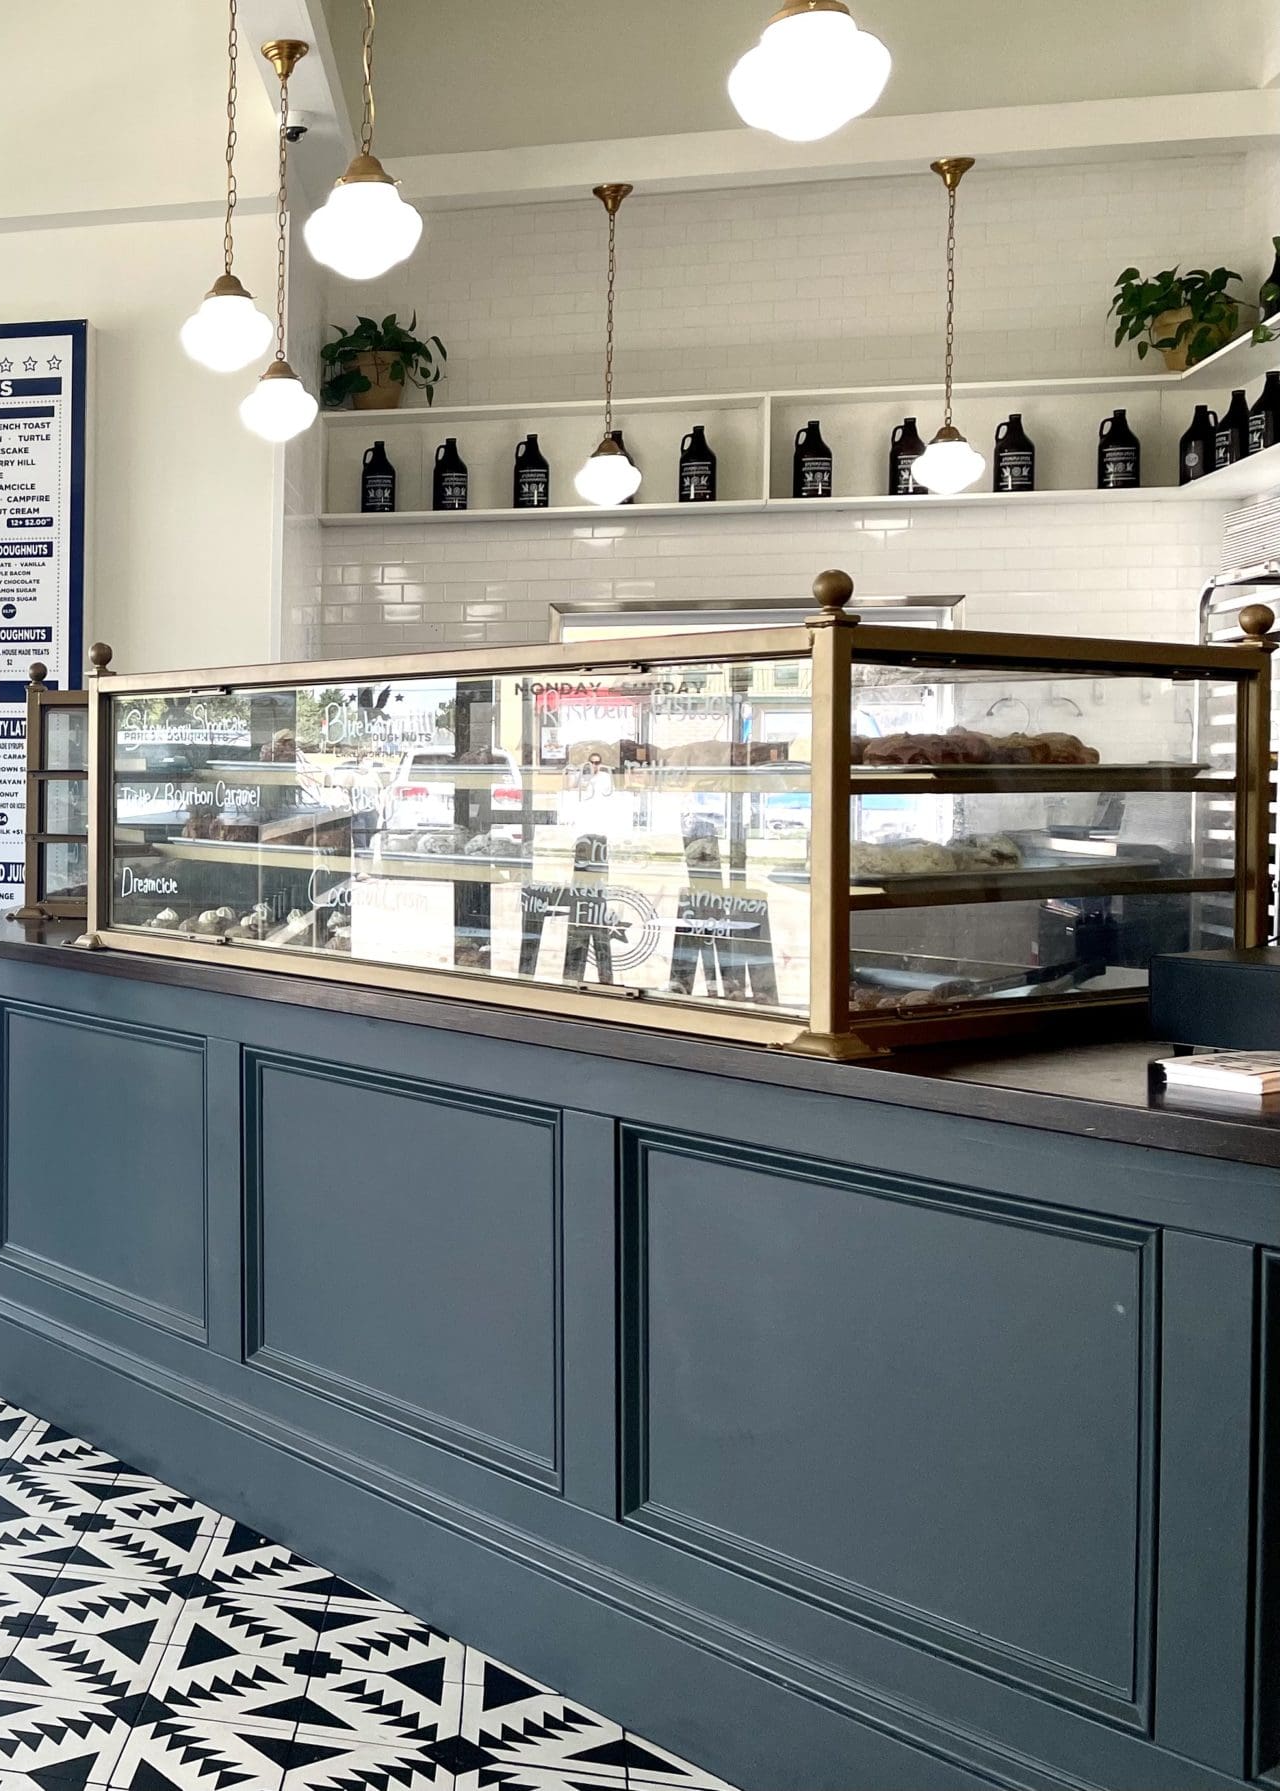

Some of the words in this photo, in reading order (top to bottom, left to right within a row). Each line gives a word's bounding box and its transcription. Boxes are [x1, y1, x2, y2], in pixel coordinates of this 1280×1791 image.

[22, 421, 51, 429] TOAST
[17, 433, 51, 441] TURTLE
[17, 458, 36, 466] HILL
[6, 494, 51, 503] CAMPFIRE
[9, 507, 40, 515] CREAM
[515, 682, 602, 696] MONDAY
[10, 720, 26, 736] LAT
[371, 732, 432, 743] OUGHNUTS
[164, 781, 214, 806] Bourbon
[215, 780, 261, 808] Caramel
[7, 864, 25, 883] JUI
[121, 866, 178, 898] Dreamcicle
